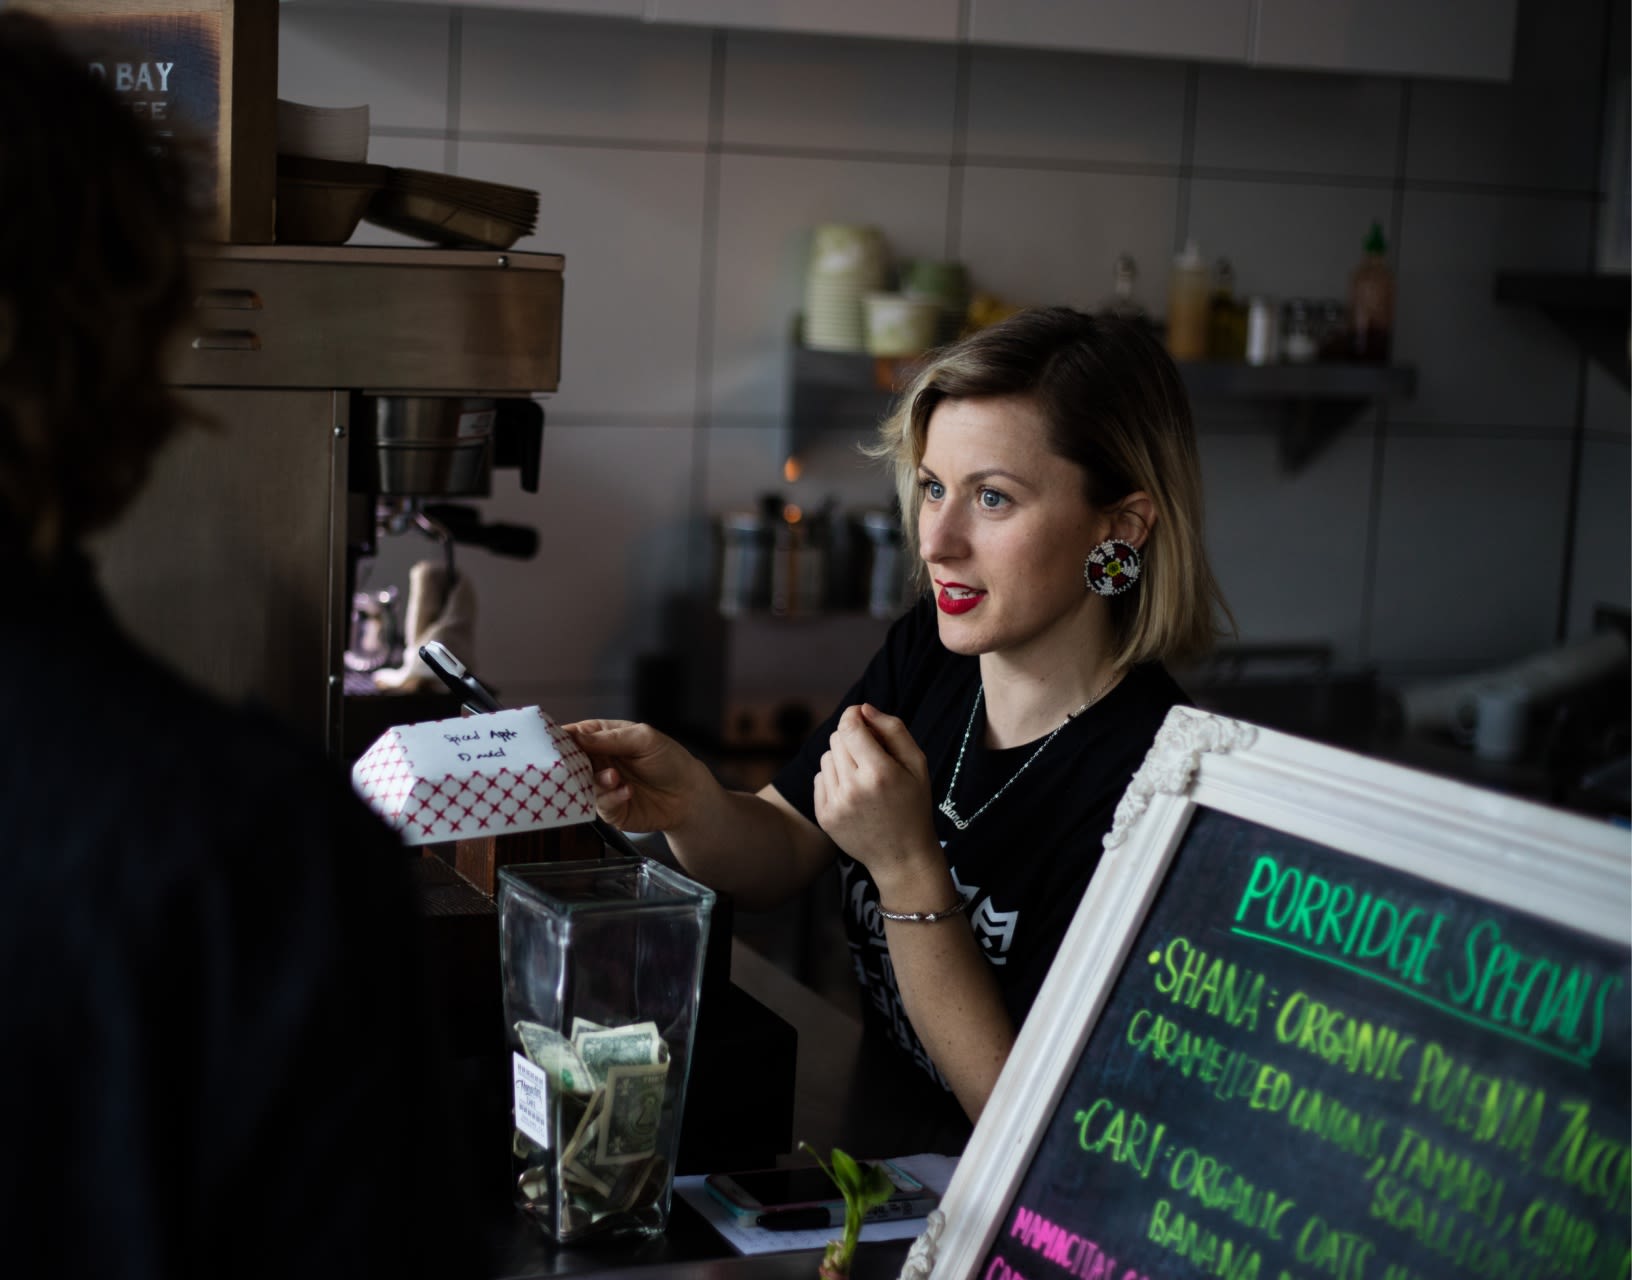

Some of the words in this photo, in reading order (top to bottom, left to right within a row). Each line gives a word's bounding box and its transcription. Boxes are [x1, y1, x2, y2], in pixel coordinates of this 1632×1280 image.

[115, 62, 174, 92] BAY
[1234, 855, 1448, 985] PORRIDGE
[1446, 918, 1624, 1060] SPECIALS
[1275, 991, 1416, 1081] ORGANIC
[1170, 1147, 1296, 1240] ORGANIC
[1149, 1200, 1262, 1280] BANANA
